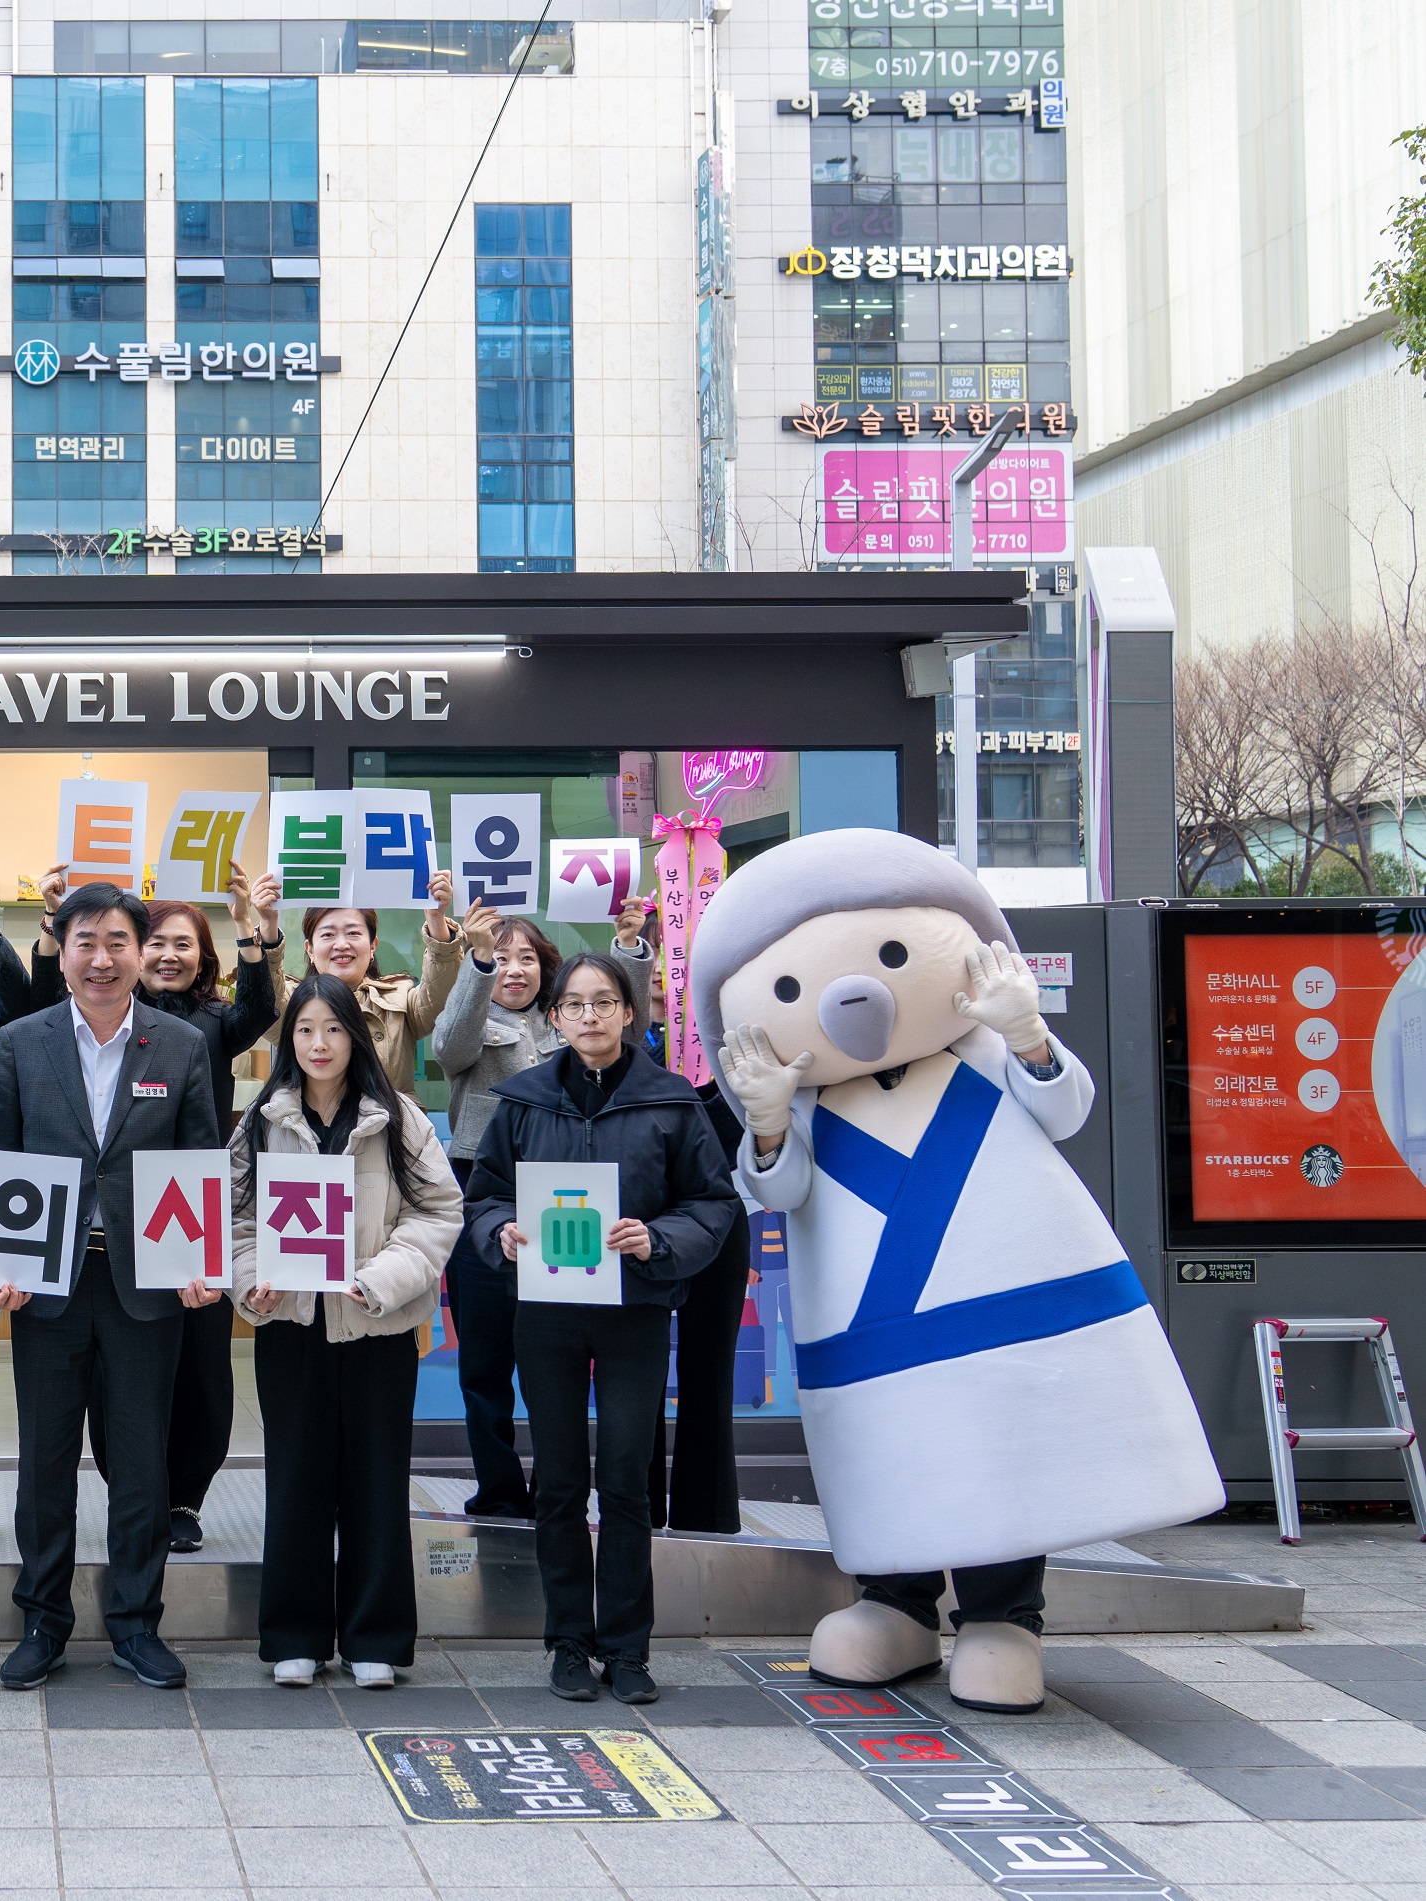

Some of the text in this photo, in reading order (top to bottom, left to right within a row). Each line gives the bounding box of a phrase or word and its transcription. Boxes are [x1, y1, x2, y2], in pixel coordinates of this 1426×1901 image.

[816, 49, 1060, 77] 7층 051) 710-7976
[1043, 79, 1065, 126] 의원
[829, 245, 1067, 279] 장창덕치과의원
[74, 341, 319, 382] 수풀림한의원
[817, 373, 851, 385] 구강외과
[860, 376, 892, 386] 환자중심
[952, 376, 973, 387] 802
[991, 368, 1020, 379] 건강한
[821, 386, 846, 396] 전문의
[991, 378, 1020, 389] 자연치
[949, 388, 977, 399] 2874
[292, 399, 315, 415] 4F
[35, 437, 125, 460] 면역관리
[201, 437, 297, 460] 다이어트
[988, 457, 1051, 472] 한방다이어트
[831, 475, 1058, 520] 슬림핏의원
[864, 533, 935, 551] 문의 051)
[1058, 566, 1071, 593] 의원
[169, 669, 451, 723] LOUNGE
[1067, 735, 1080, 748] 2F
[68, 804, 631, 917] 트 래 블 라 운 지
[666, 868, 684, 930] 부산진
[1206, 973, 1281, 990] 문화HALL
[1305, 981, 1324, 994] 5F
[1208, 994, 1245, 1004] VIP라운지
[1211, 1024, 1276, 1042] 수술센터
[1307, 1032, 1327, 1045] 4F
[1213, 1076, 1279, 1094] 외래진료
[1310, 1086, 1329, 1099] 3F
[1205, 1155, 1290, 1166] STARBUCKS
[1242, 1168, 1274, 1178] 스타벅스
[143, 1176, 352, 1282] 시 작
[1208, 1270, 1252, 1280] 지상배전함
[463, 1735, 603, 1816] 금연거리
[556, 1737, 640, 1813] No Smoking Area
